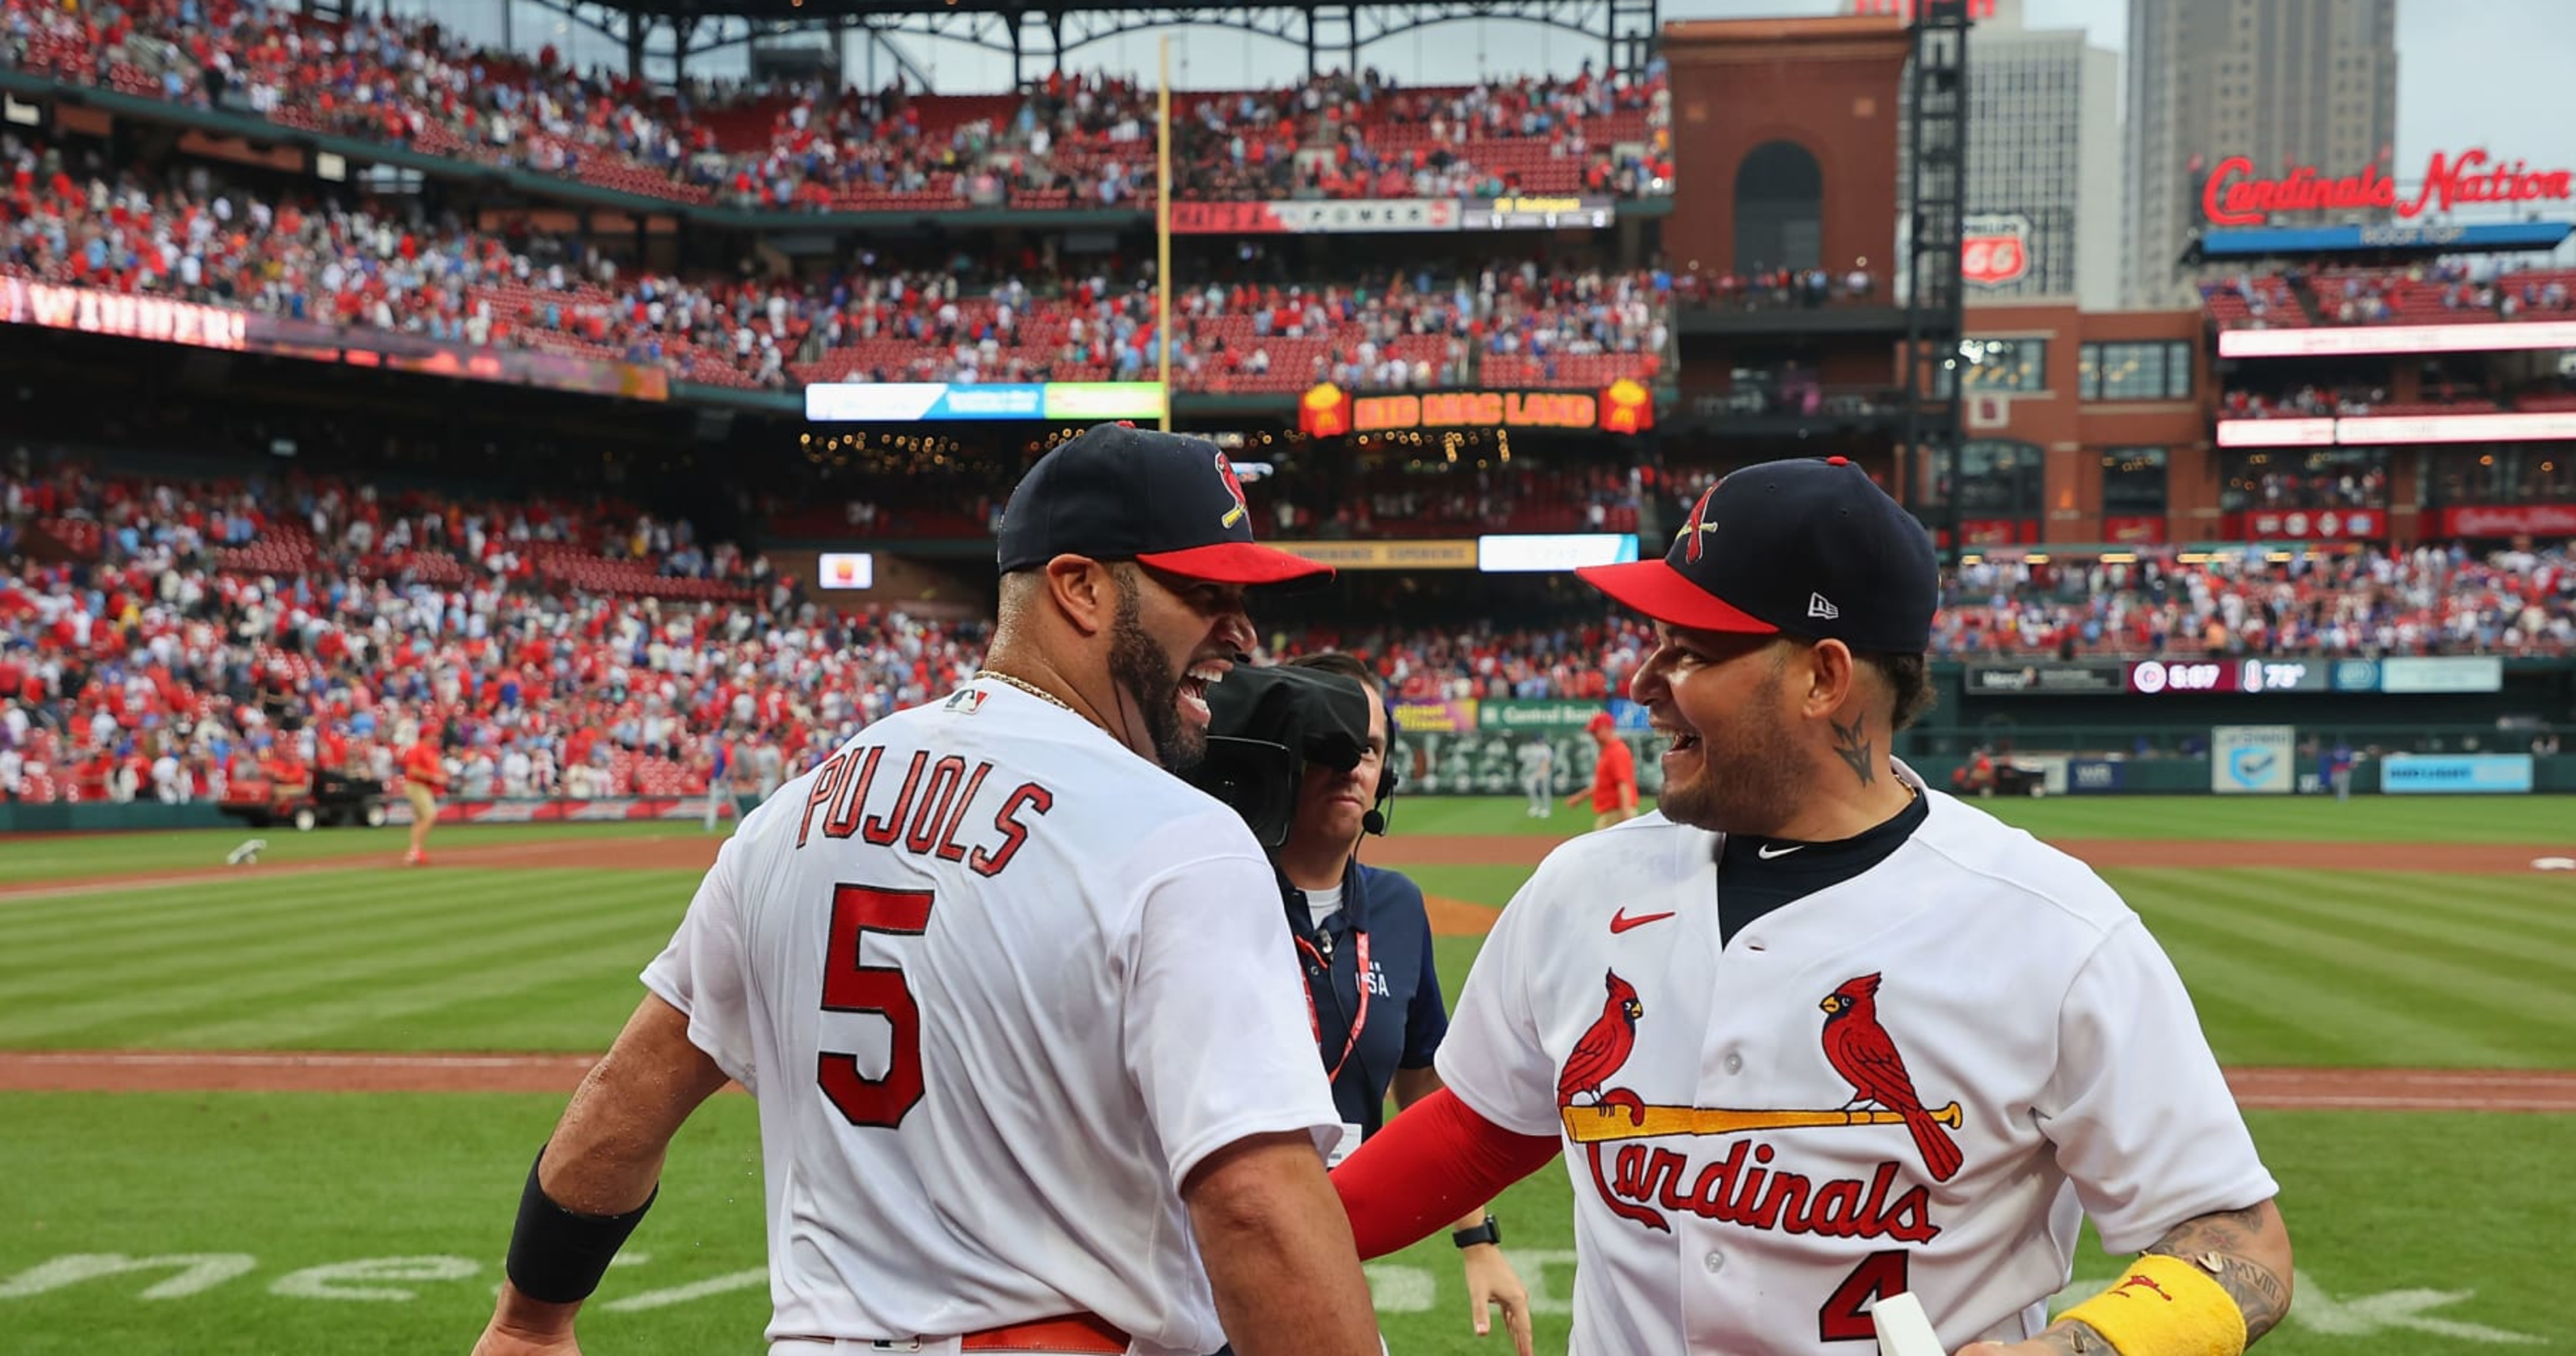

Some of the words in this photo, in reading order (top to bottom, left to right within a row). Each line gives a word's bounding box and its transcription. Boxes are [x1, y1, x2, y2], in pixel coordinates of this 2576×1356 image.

[2202, 156, 2396, 226] Cardinals
[2398, 148, 2575, 218] Nation
[1964, 243, 2013, 274] 66
[1422, 393, 1504, 426] MAC
[1504, 393, 1596, 428] LAND
[1503, 705, 1558, 723] Central
[797, 745, 1053, 877] PUJOLS
[817, 883, 935, 1130] 5
[1586, 1119, 1942, 1244] Cardinals
[1819, 1249, 1909, 1356] 4
